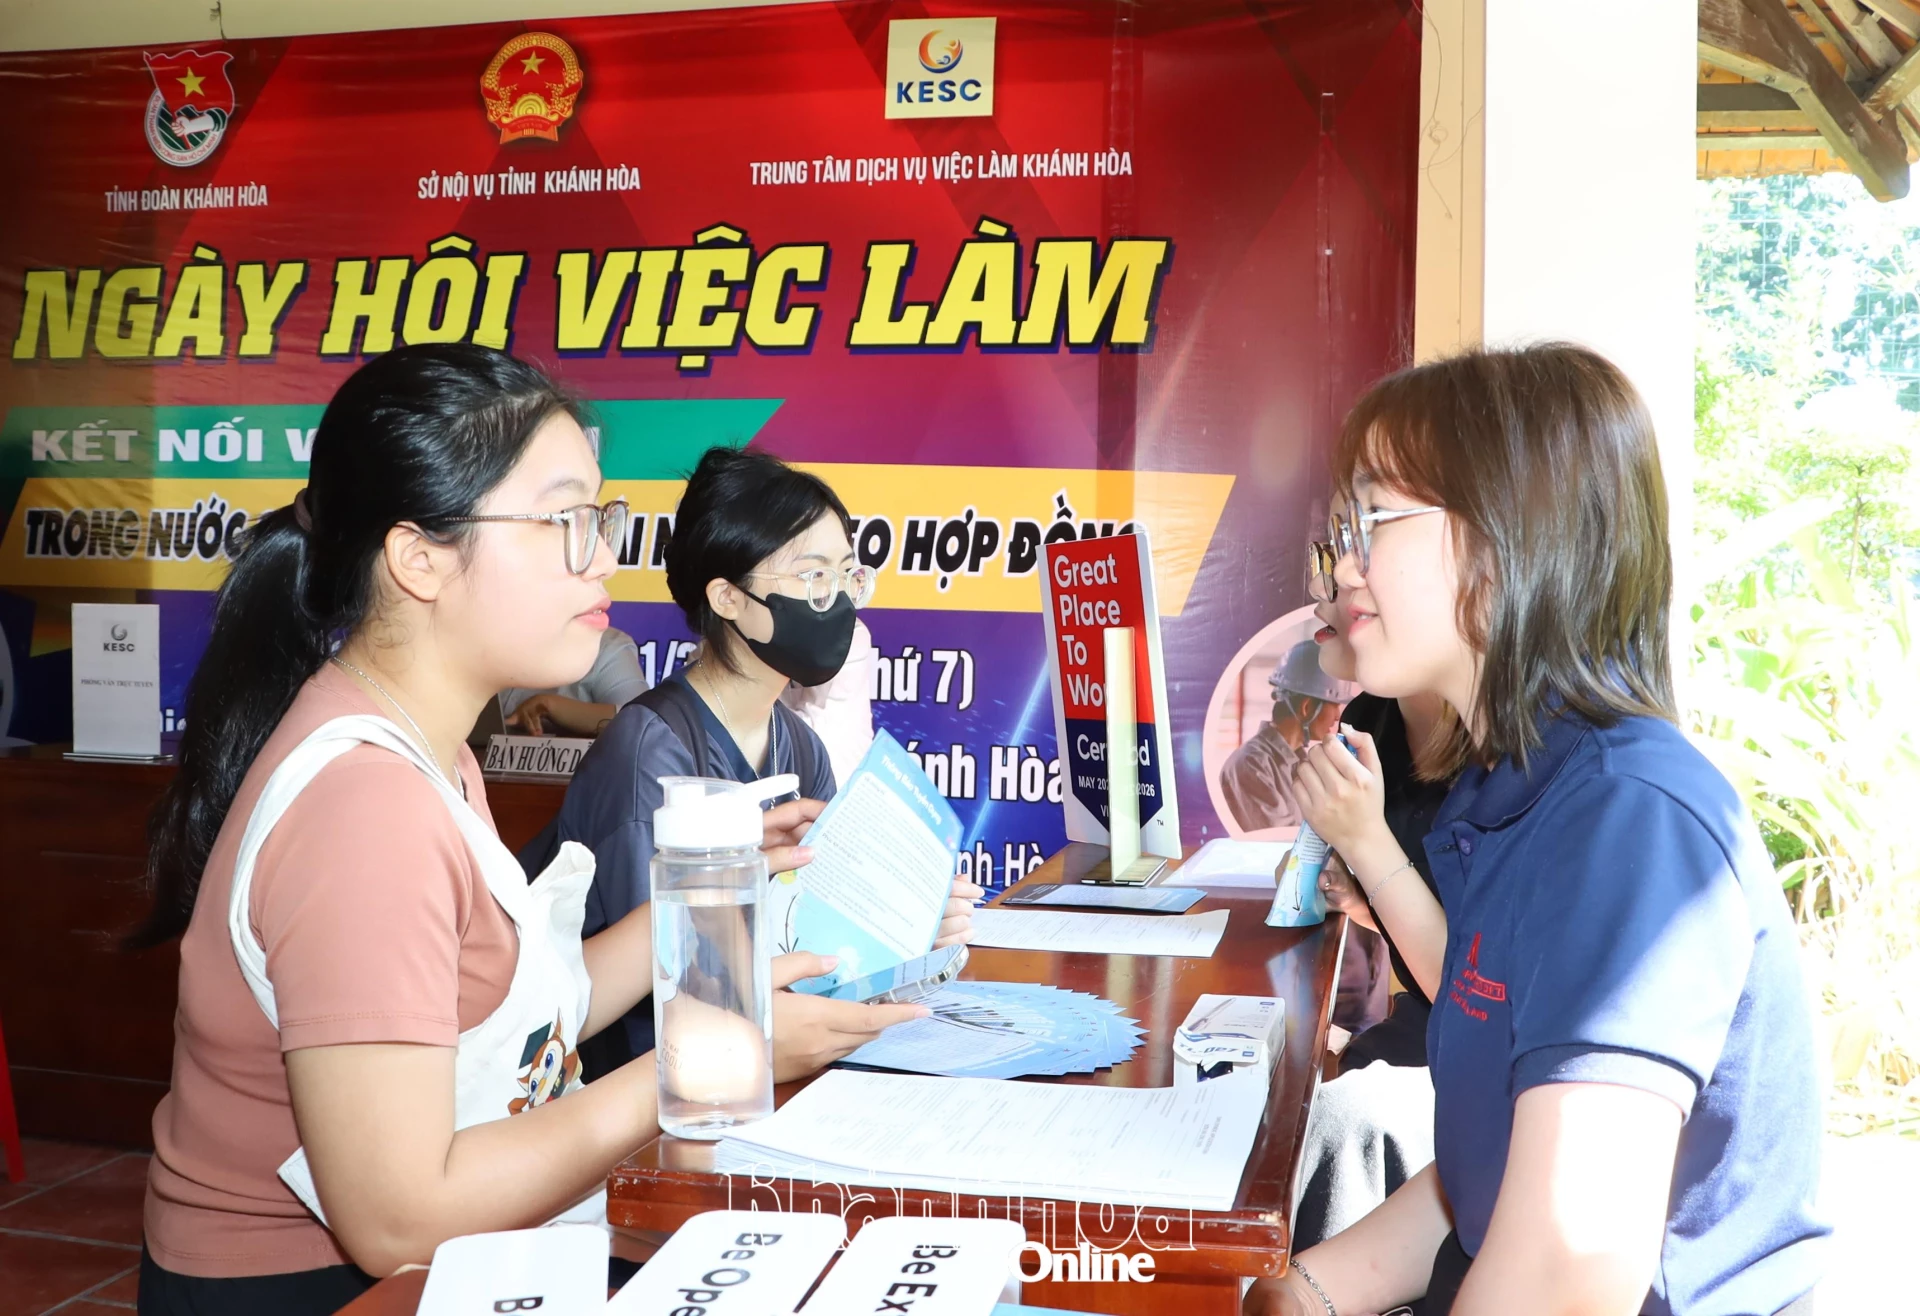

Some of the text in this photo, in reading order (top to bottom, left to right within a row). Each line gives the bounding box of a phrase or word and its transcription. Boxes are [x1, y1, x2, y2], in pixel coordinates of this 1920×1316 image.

[897, 79, 982, 103] KESC
[418, 163, 641, 201] SỞ NỘI VỤ TỈNH KHÁNH HÒA
[750, 147, 1132, 186] TRUNG TÂM DỊCH VỤ VIỆC LÀM KHÁNH HÒA
[105, 181, 268, 212] TỈNH ĐOÀN KHÁNH HÒA
[13, 244, 305, 360] NGÀY
[556, 223, 829, 372] VIỆC
[848, 217, 1170, 347] LÀM
[32, 419, 138, 461] KẾT
[158, 416, 262, 462] NỐI
[25, 509, 140, 559] TRONG
[147, 495, 248, 559] NƯỚC
[900, 508, 1000, 589] HỢP
[1007, 494, 1135, 574] ĐỒ
[1054, 553, 1118, 588] Great
[1060, 594, 1121, 627] Place
[103, 643, 135, 652] KESC
[1062, 635, 1088, 666] To
[931, 649, 975, 711] 7)
[1067, 674, 1107, 707] Wo
[516, 740, 570, 773] HƯỚNG
[1078, 775, 1096, 789] MAY
[714, 1232, 783, 1261] Be
[901, 1244, 960, 1275] Be
[493, 1295, 544, 1316] B
[874, 1282, 938, 1316] Ex
